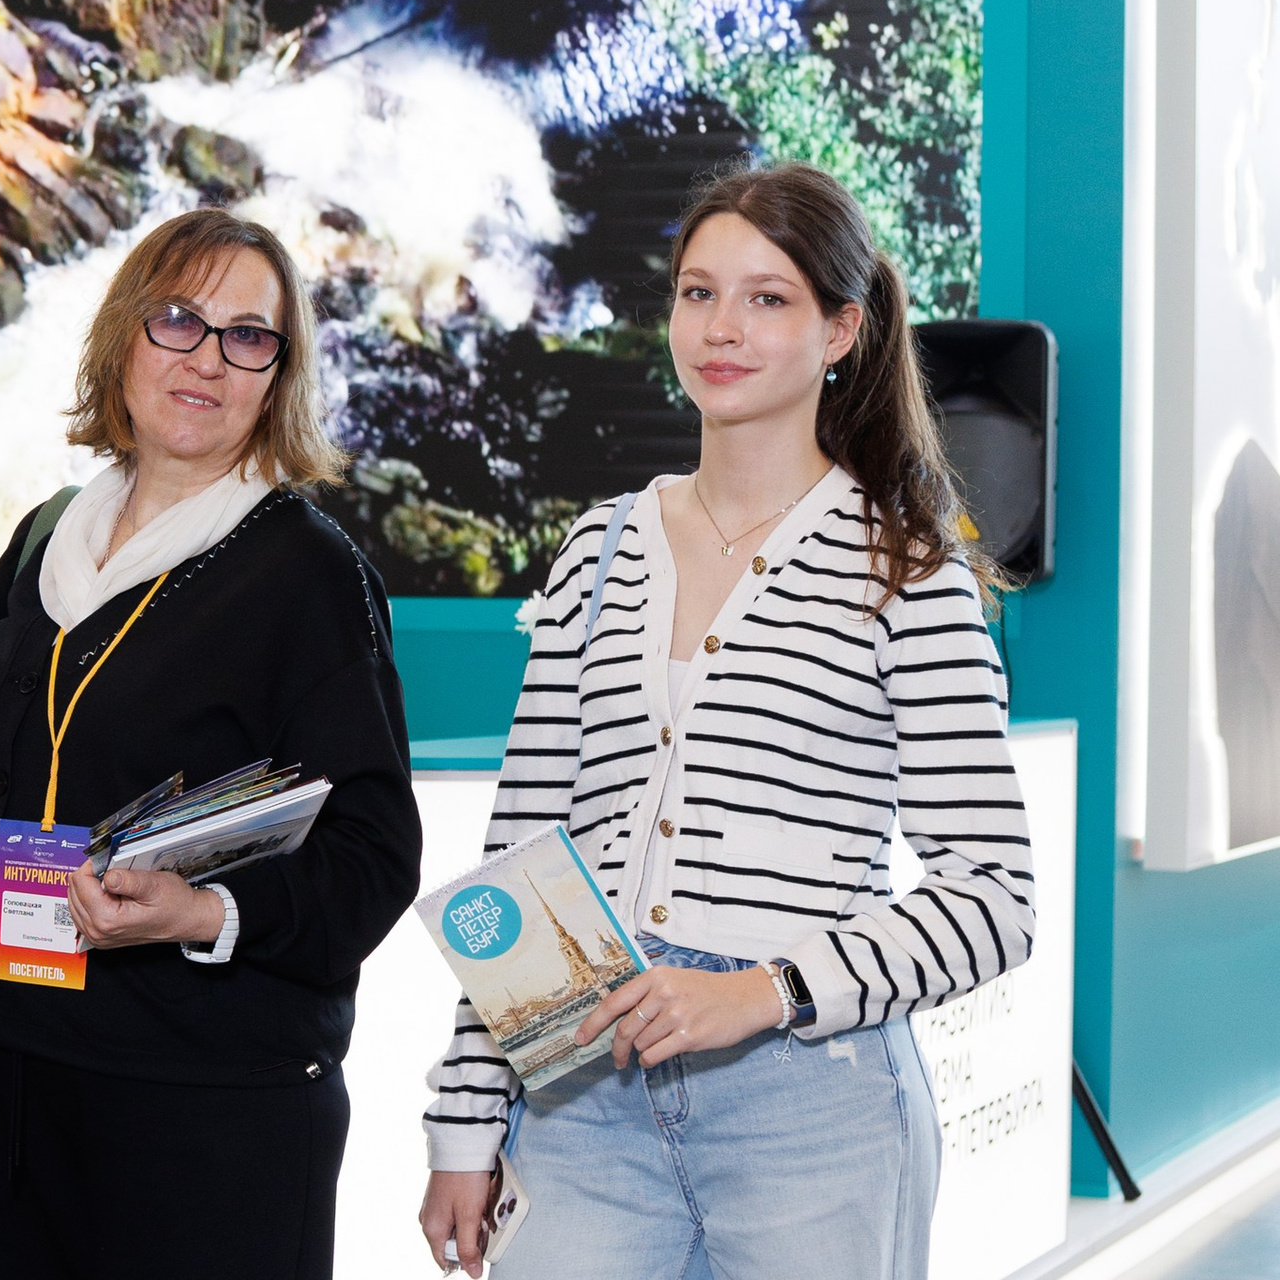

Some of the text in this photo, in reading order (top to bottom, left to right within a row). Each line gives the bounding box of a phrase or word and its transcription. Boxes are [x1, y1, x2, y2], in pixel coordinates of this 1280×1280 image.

[4, 865, 70, 887] ИНТУРМАРК
[449, 891, 495, 925] САНКТ
[457, 906, 502, 940] ПЕТЕР
[466, 925, 501, 955] БУРГ
[9, 961, 66, 981] ПОСЕТИТЕЛЬ
